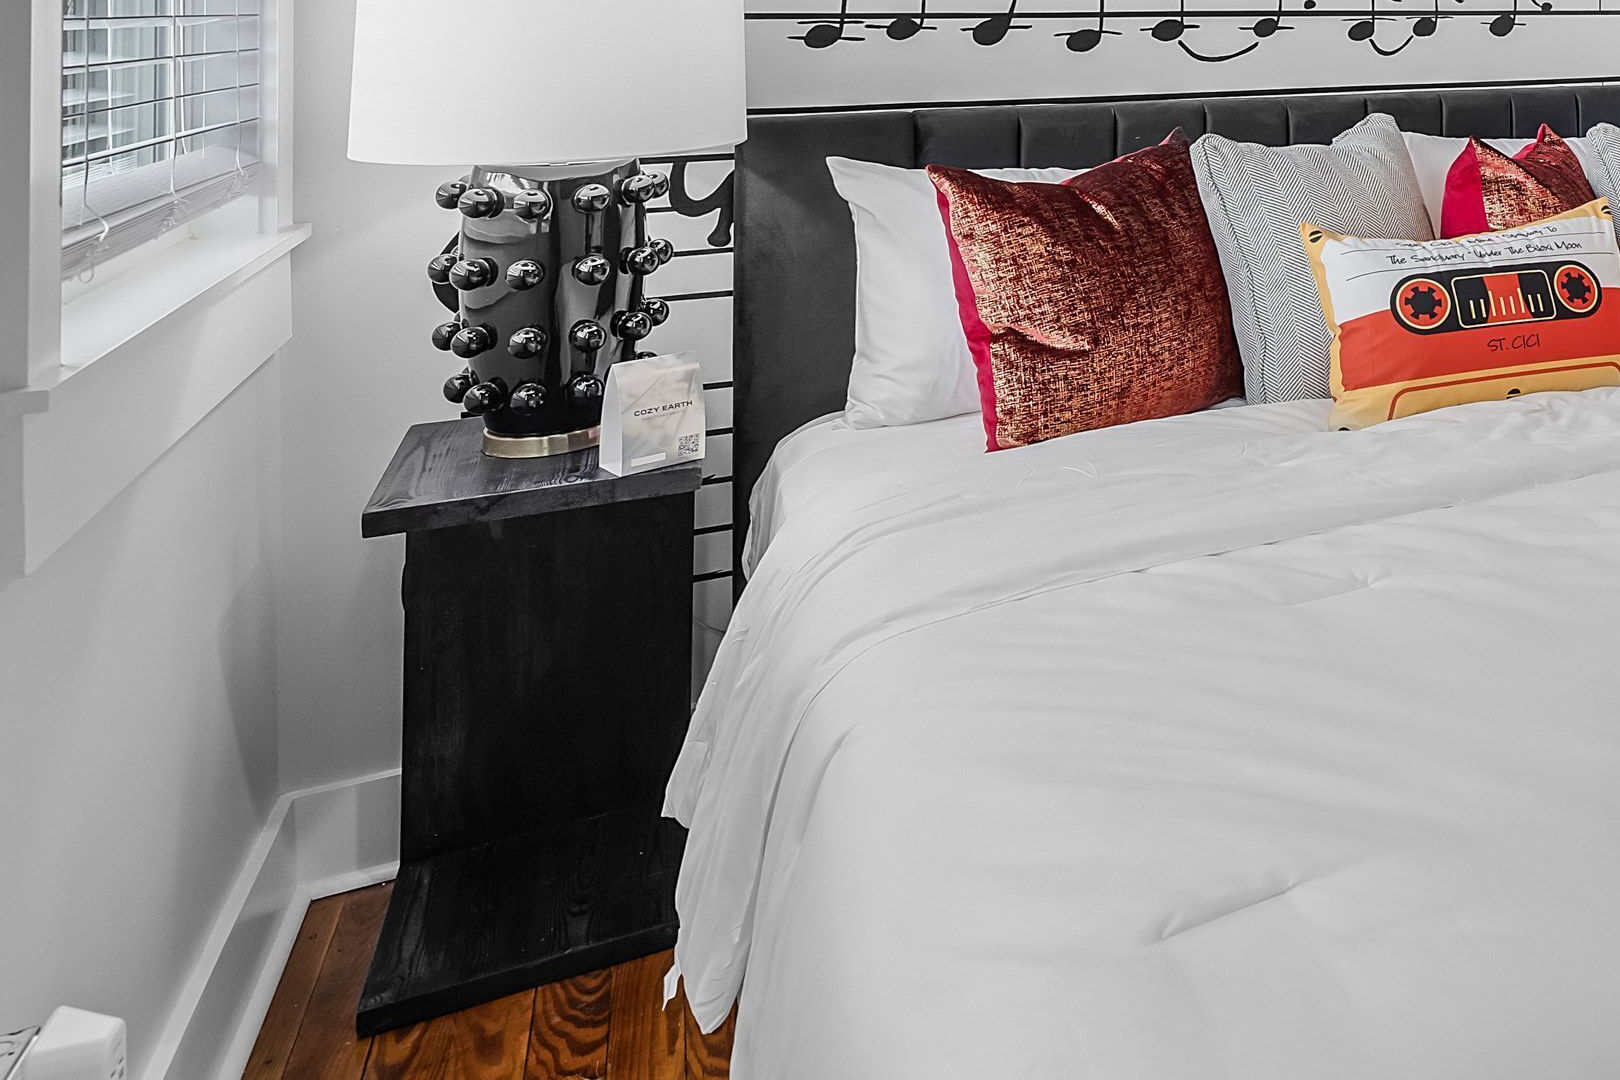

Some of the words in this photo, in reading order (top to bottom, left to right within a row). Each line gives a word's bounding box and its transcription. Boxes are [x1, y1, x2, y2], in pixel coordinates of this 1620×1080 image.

[1387, 254, 1407, 265] The
[1473, 250, 1502, 259] Under
[1505, 246, 1524, 256] The
[1554, 240, 1583, 250] Moon
[634, 407, 660, 417] COZY
[662, 400, 692, 411] EARTH
